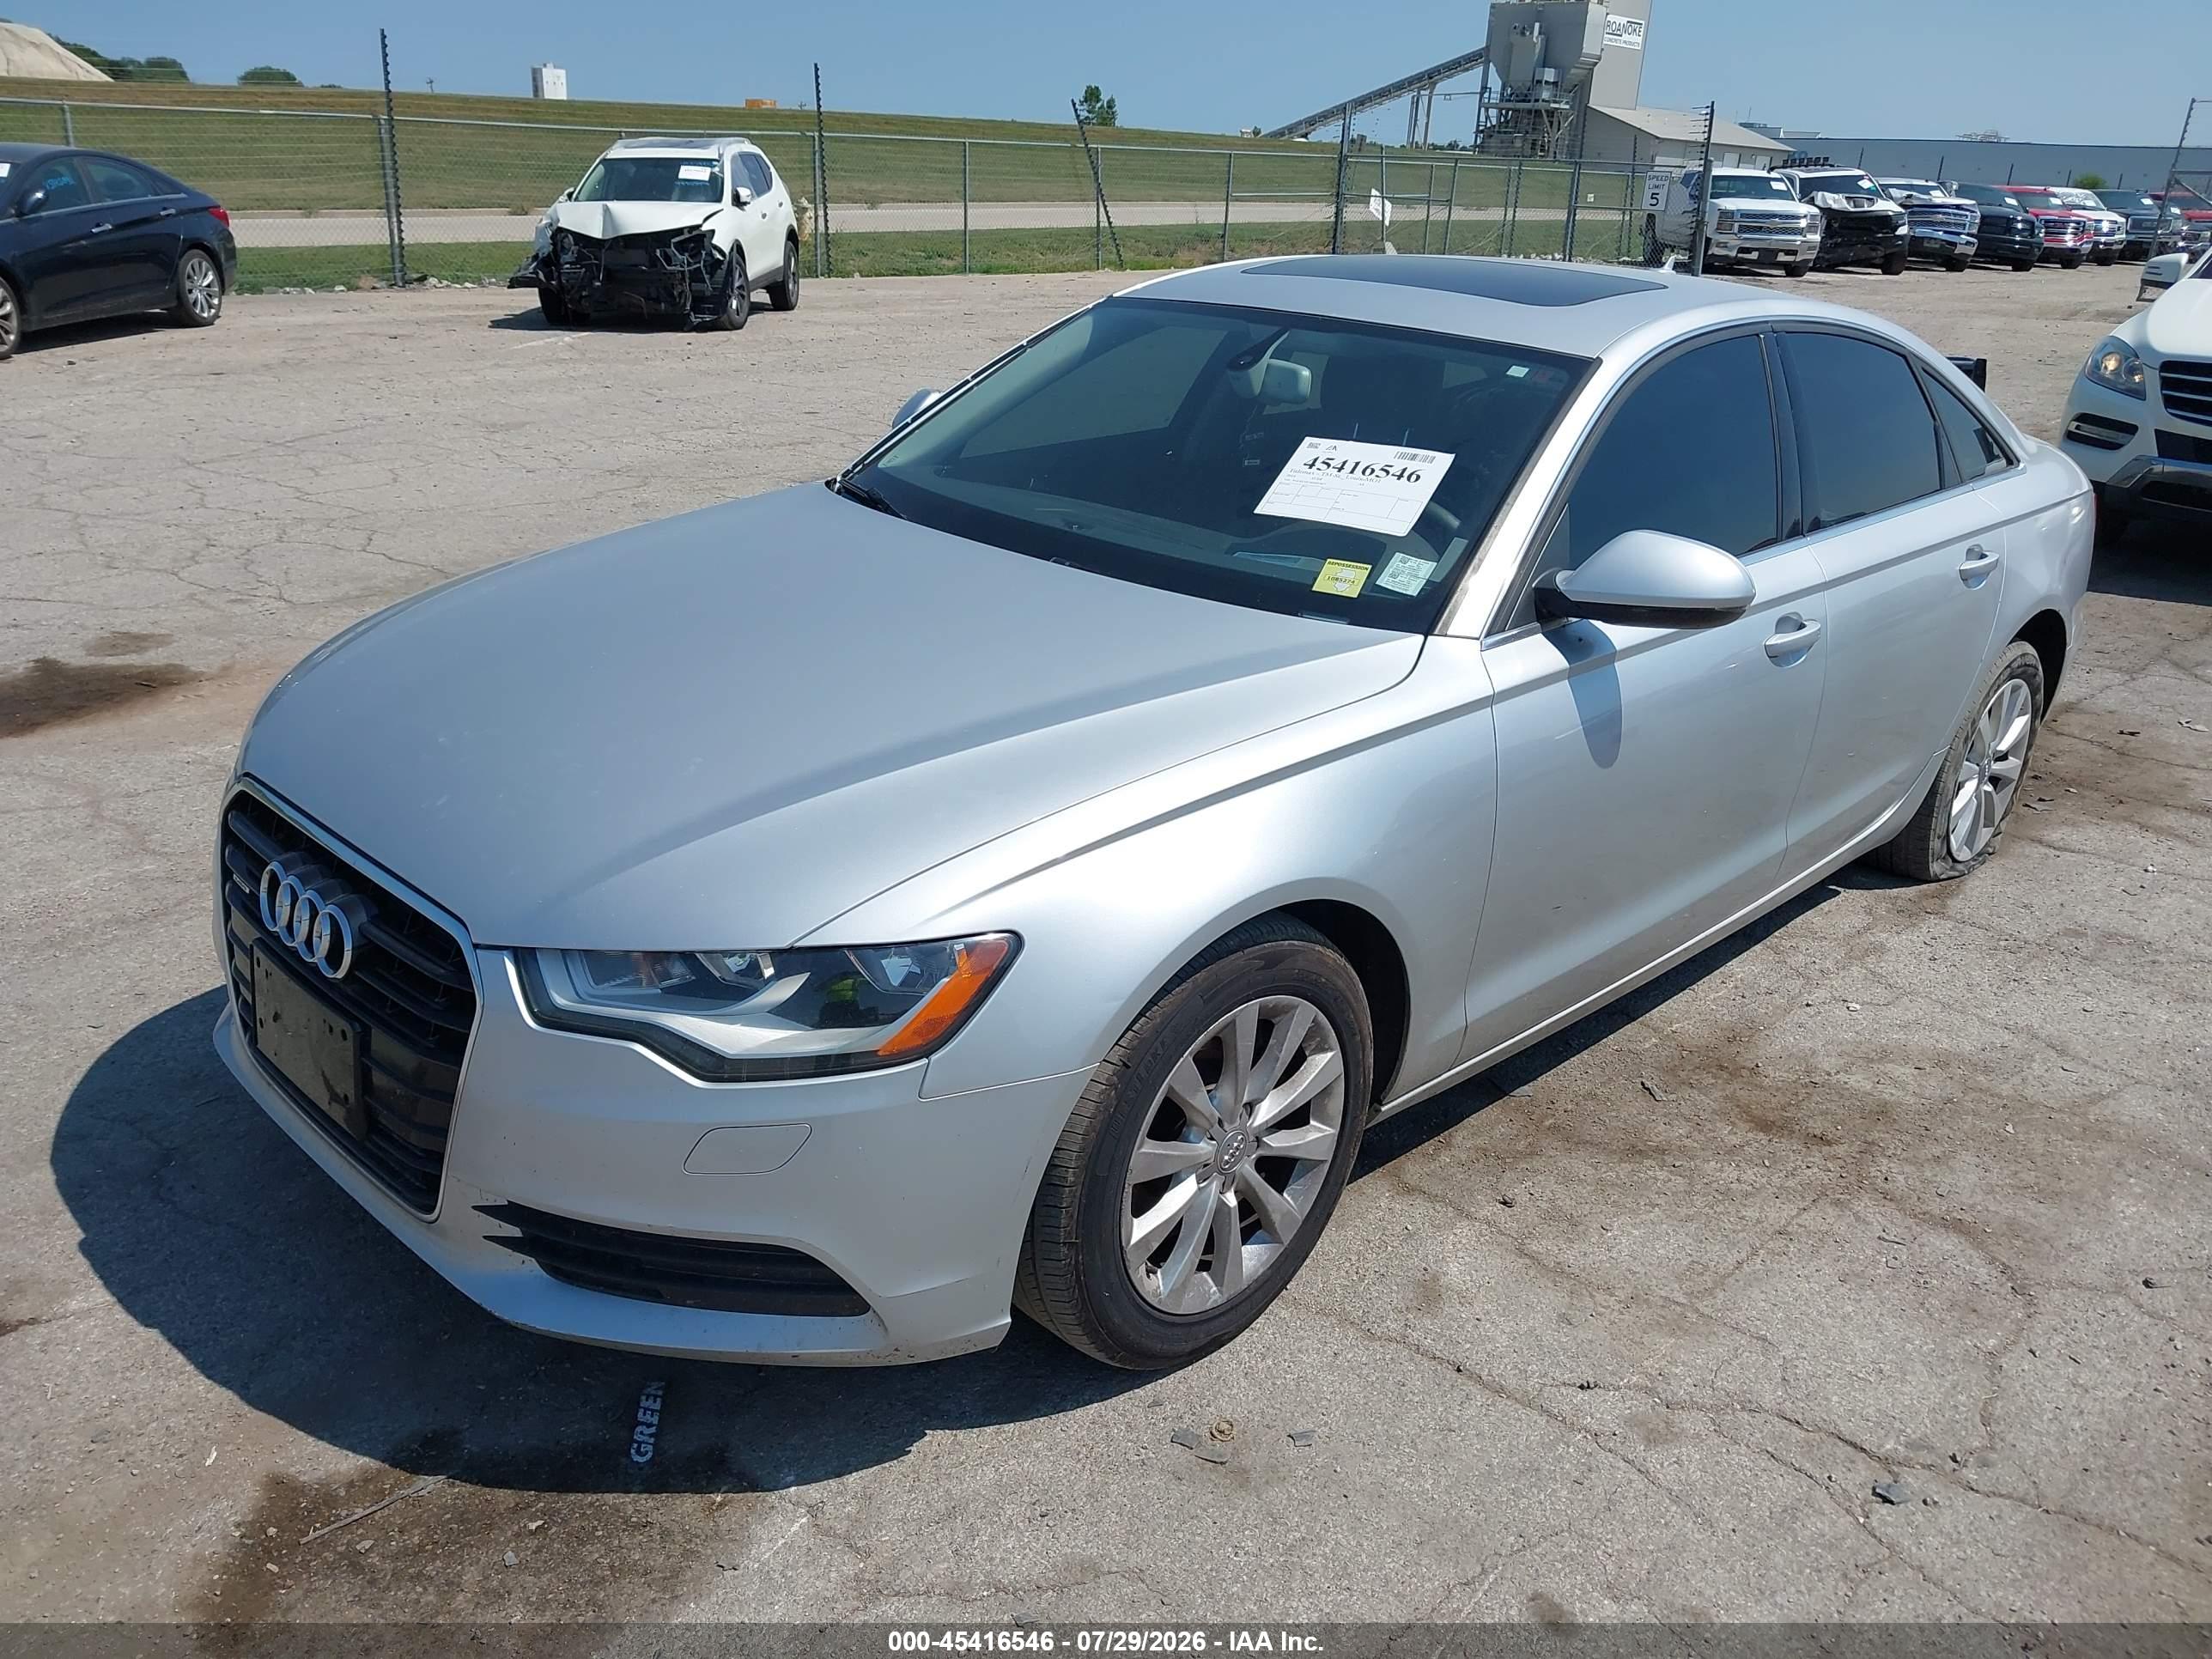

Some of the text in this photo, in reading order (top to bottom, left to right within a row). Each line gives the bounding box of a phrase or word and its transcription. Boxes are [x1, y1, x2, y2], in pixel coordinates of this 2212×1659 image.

[1606, 20, 1643, 37] ROANOKE
[1649, 191, 1660, 207] 5
[1303, 455, 1422, 483] 45416546
[1327, 561, 1370, 571] REPOSSESSION
[630, 1381, 665, 1462] GREEN
